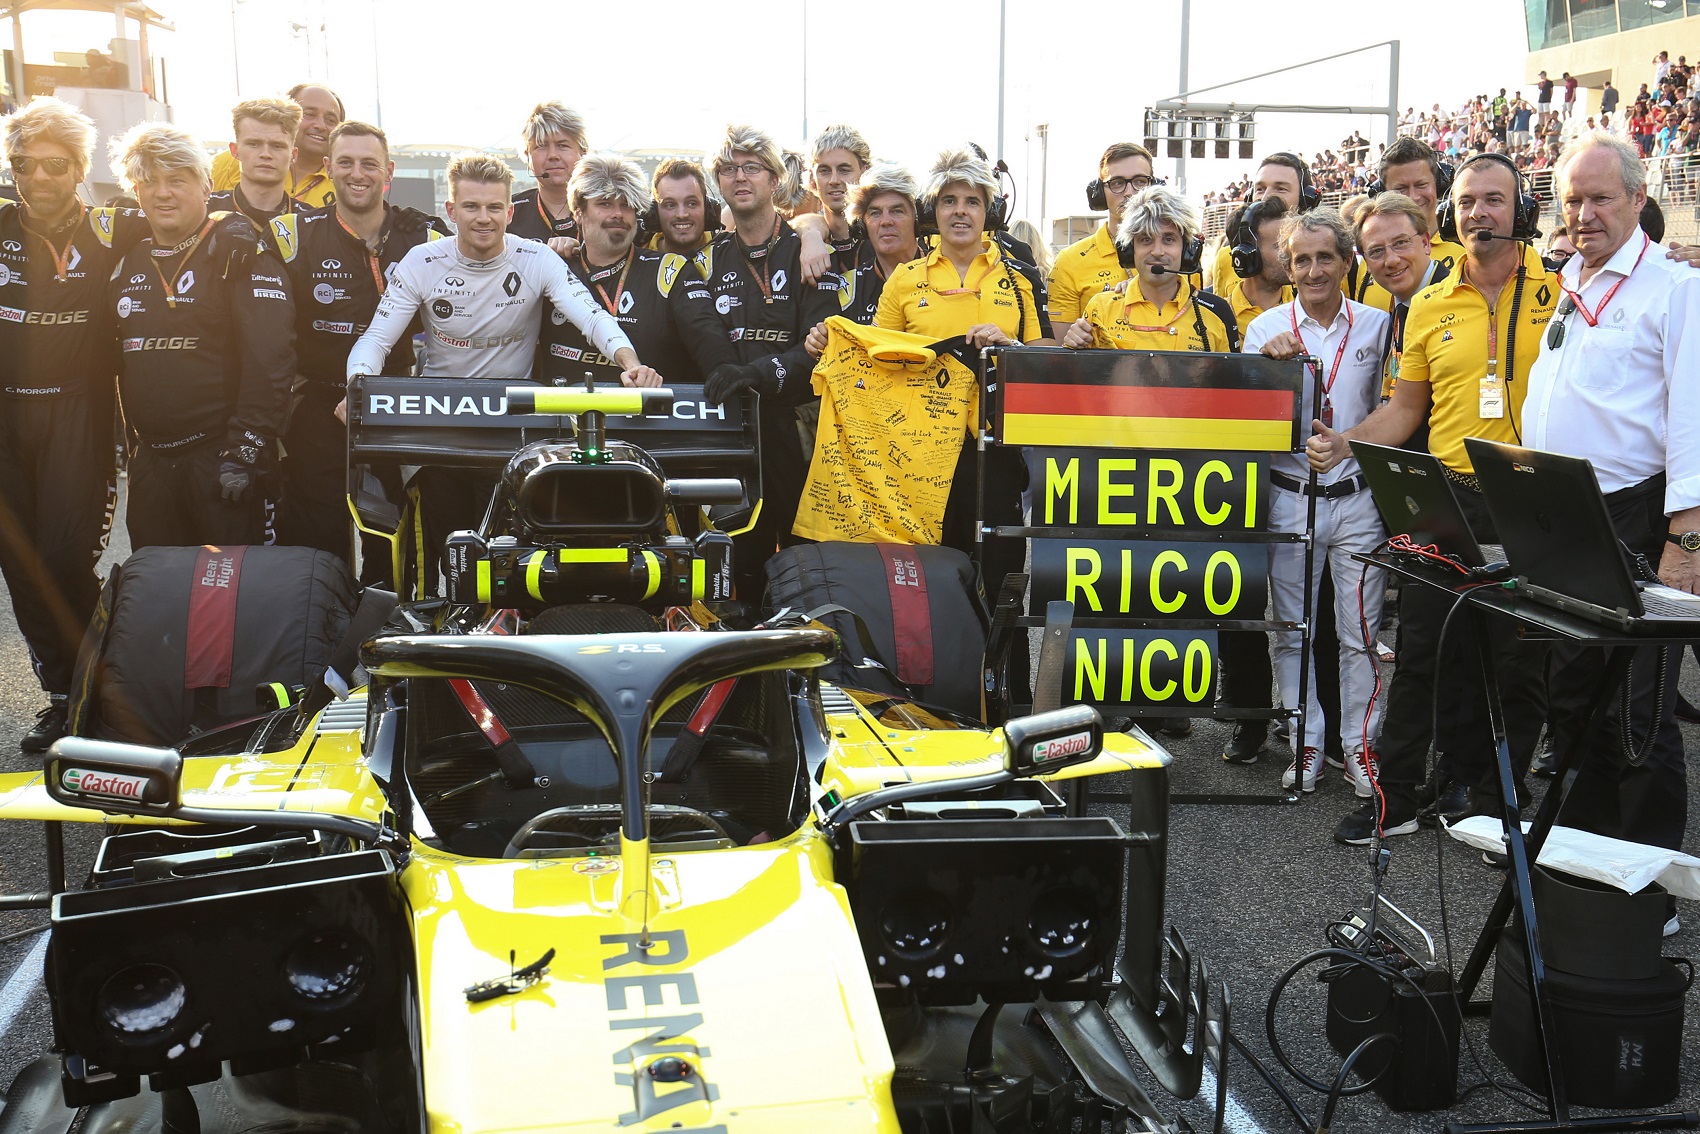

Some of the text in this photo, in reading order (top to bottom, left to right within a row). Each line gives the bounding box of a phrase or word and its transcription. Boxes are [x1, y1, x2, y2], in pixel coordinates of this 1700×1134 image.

[433, 287, 477, 297] INFINITI
[495, 298, 526, 308] RENAULT
[25, 310, 89, 325] EDGE
[323, 322, 351, 333] Castrol
[143, 337, 200, 351] EDGE
[436, 331, 470, 348] Castrol
[554, 346, 580, 360] Castrol
[848, 366, 880, 379] INFINITI
[16, 386, 62, 395] MORGAN
[928, 389, 952, 397] RENAULT
[369, 394, 509, 416] RENAU
[1414, 468, 1427, 476] NICO
[1520, 465, 1535, 474] NICO
[1044, 457, 1258, 528] MERCI
[201, 558, 219, 587] Rear
[215, 557, 235, 589] Right
[892, 557, 907, 587] Rear
[905, 560, 919, 587] Left
[1065, 547, 1242, 616] RICO
[1073, 637, 1213, 703] NICO
[1047, 735, 1088, 759] Castrol
[80, 773, 141, 798] Castrol
[600, 928, 728, 1134] RENA
